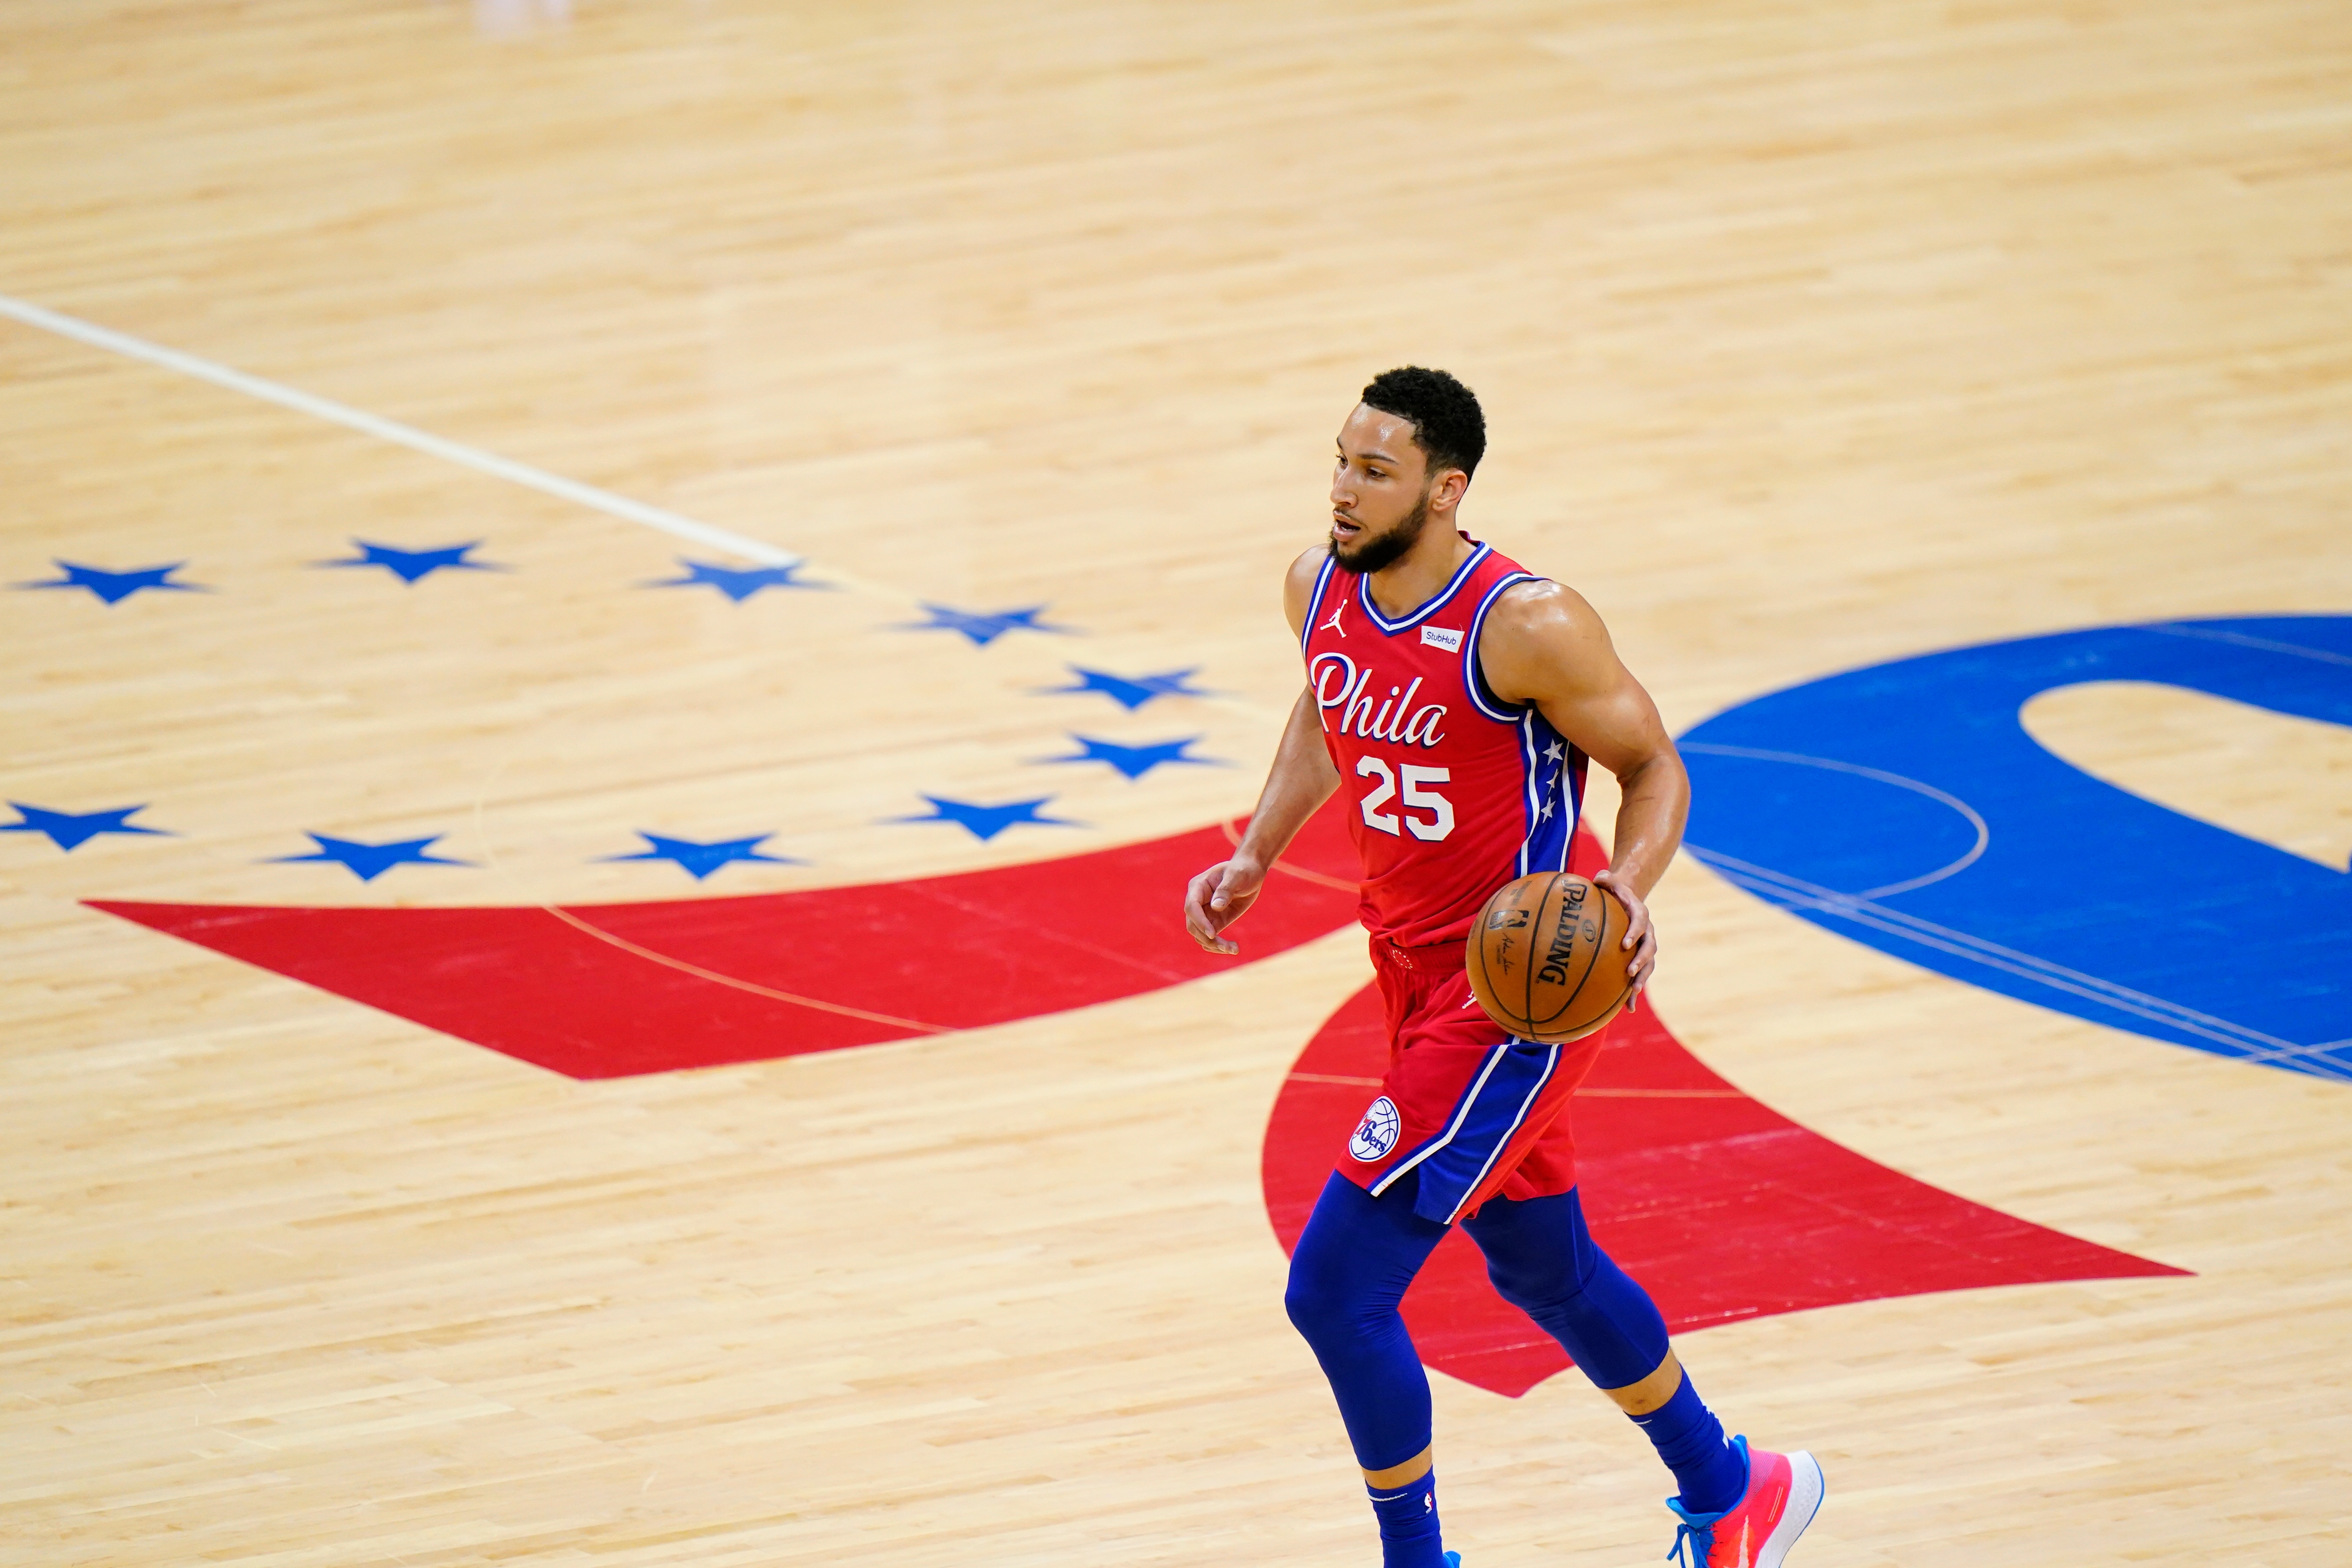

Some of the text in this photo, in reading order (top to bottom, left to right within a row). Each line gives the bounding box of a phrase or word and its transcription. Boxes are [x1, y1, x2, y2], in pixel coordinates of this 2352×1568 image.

[1426, 631, 1457, 645] StubHub
[1310, 652, 1447, 749] Phila
[1356, 755, 1455, 842] 25
